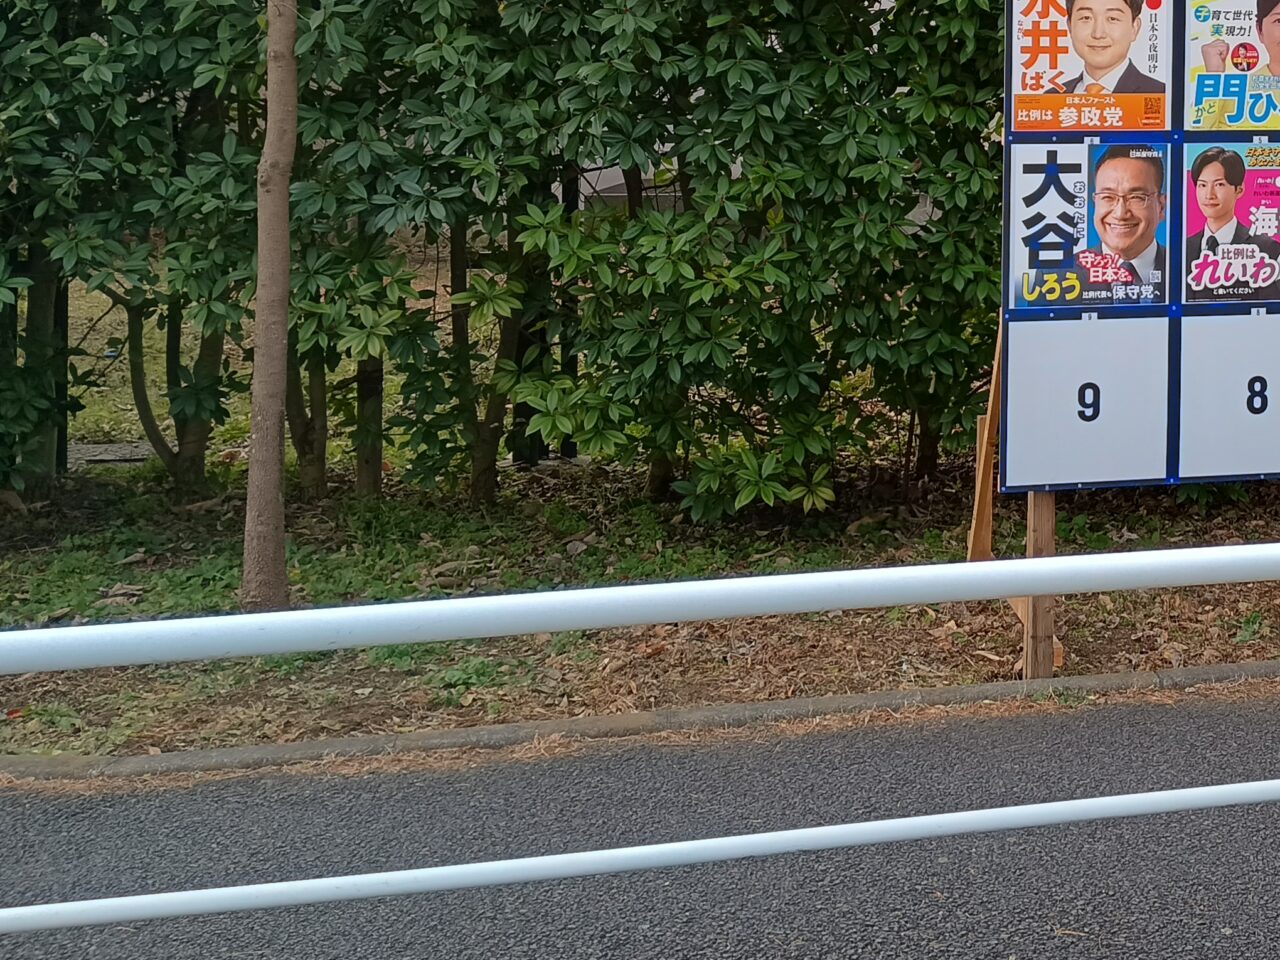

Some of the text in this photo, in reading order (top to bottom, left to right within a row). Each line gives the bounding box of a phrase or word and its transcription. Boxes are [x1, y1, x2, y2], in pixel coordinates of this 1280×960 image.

[1148, 13, 1158, 74] 日本の夜明け
[1021, 70, 1067, 93] ばく
[1058, 106, 1123, 127] 参政党
[1066, 96, 1116, 104] 日本人ファースト
[1021, 149, 1082, 269] 大谷
[1073, 181, 1085, 239] おおたに
[1191, 253, 1276, 287] れいわ
[1221, 248, 1256, 260] 比例は
[1022, 272, 1081, 301] しろう
[1077, 382, 1101, 422] 9
[1246, 376, 1269, 414] 8
